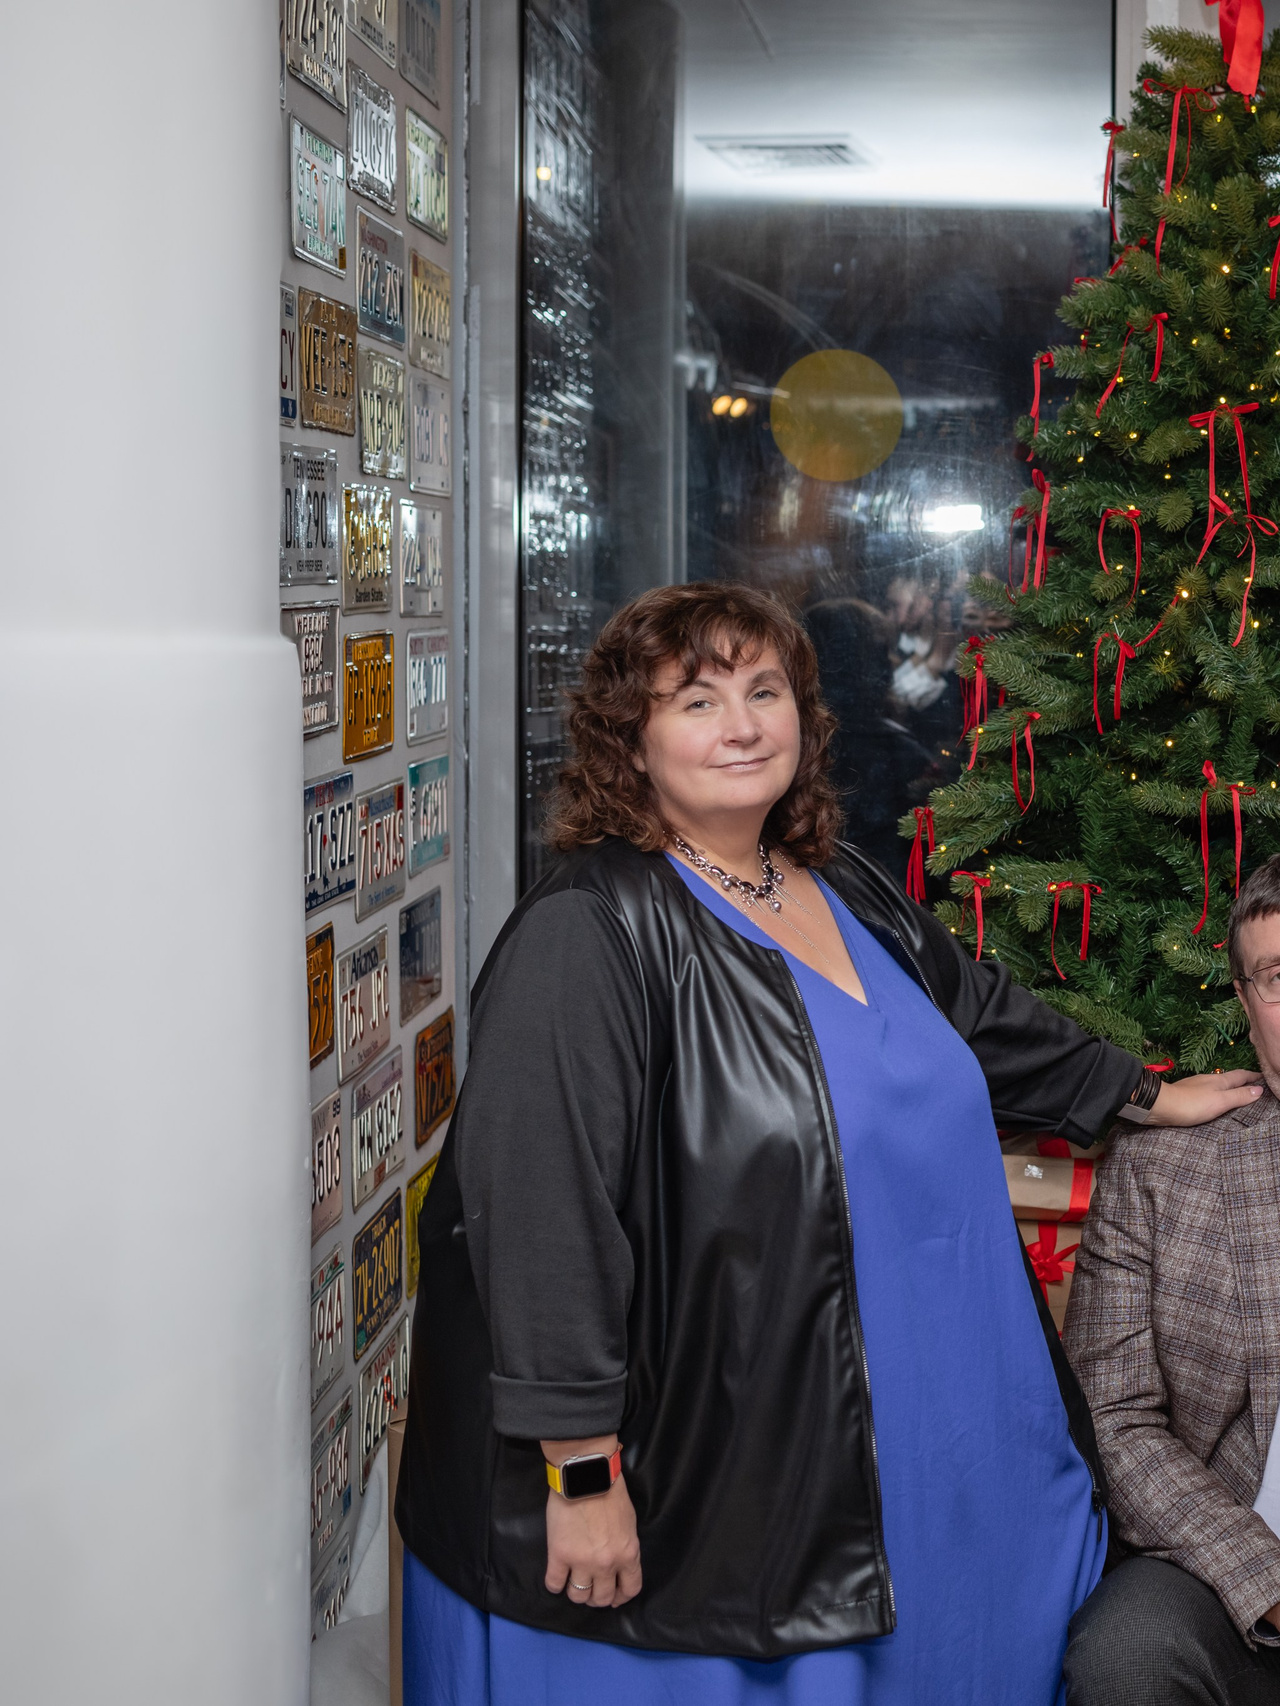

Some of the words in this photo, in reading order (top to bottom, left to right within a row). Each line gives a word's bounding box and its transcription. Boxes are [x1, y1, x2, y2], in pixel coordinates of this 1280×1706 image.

[293, 456, 324, 481] TENESSEE
[350, 937, 378, 985] Arkansas
[306, 967, 329, 1053] 59
[340, 978, 364, 1056] 756
[368, 959, 389, 1034] JPC
[356, 1217, 399, 1328] ZV-26907
[374, 1334, 396, 1380] MAINE
